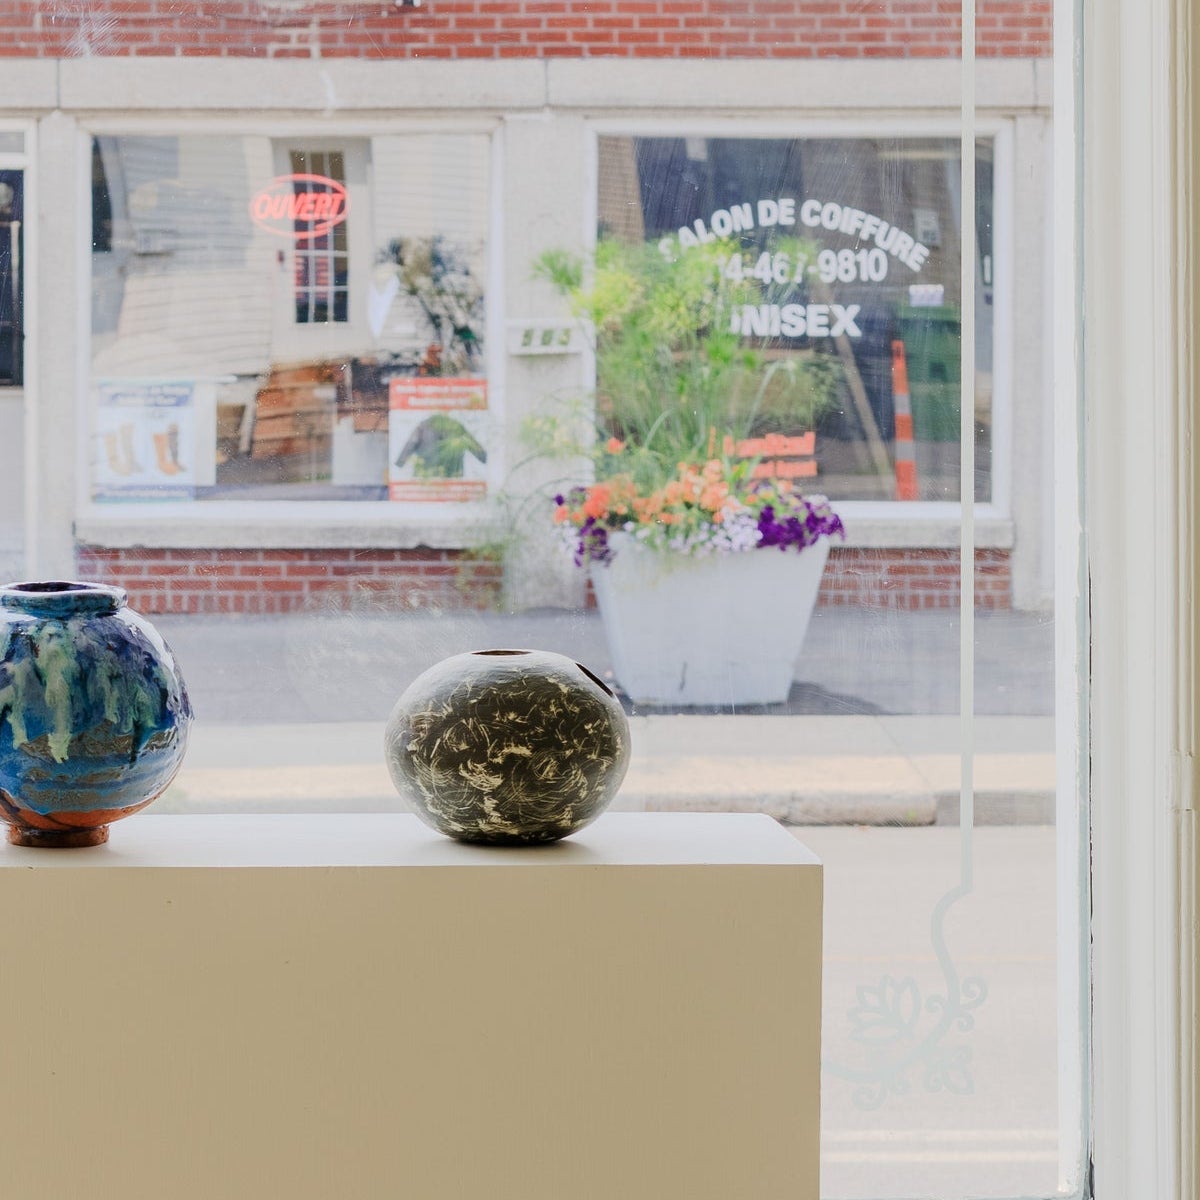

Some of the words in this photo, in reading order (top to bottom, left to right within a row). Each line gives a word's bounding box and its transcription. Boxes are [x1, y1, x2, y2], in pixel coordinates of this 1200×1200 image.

[254, 192, 345, 221] OUVERT
[658, 202, 754, 263] SALON
[757, 198, 796, 227] DE
[800, 199, 930, 273] COIFFURE
